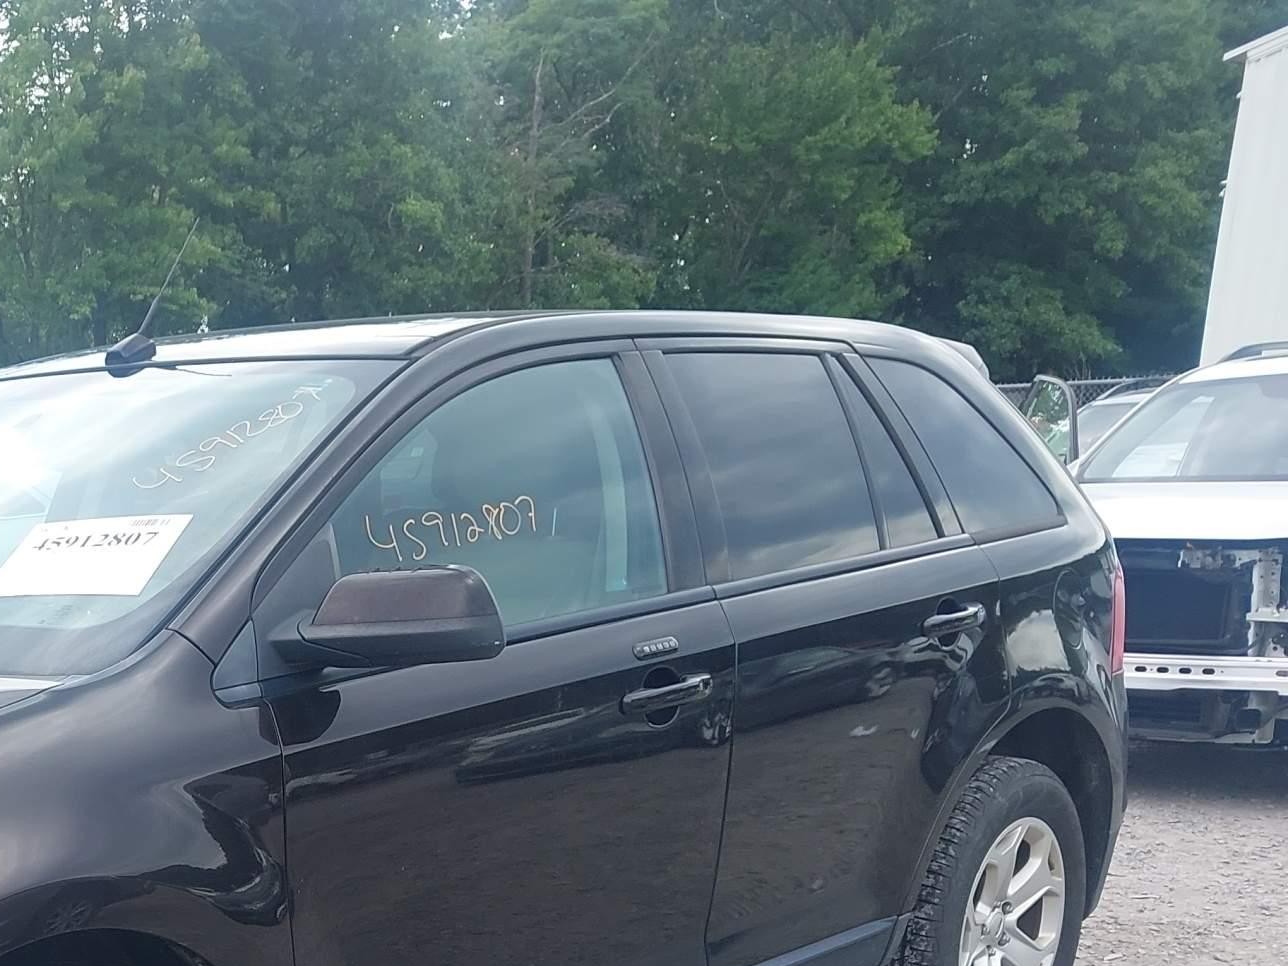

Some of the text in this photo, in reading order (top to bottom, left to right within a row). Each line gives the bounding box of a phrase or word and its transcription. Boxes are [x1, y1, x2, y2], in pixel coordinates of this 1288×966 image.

[132, 382, 330, 489] 45912807
[32, 531, 160, 551] 45912807
[365, 495, 537, 562] 45912807
